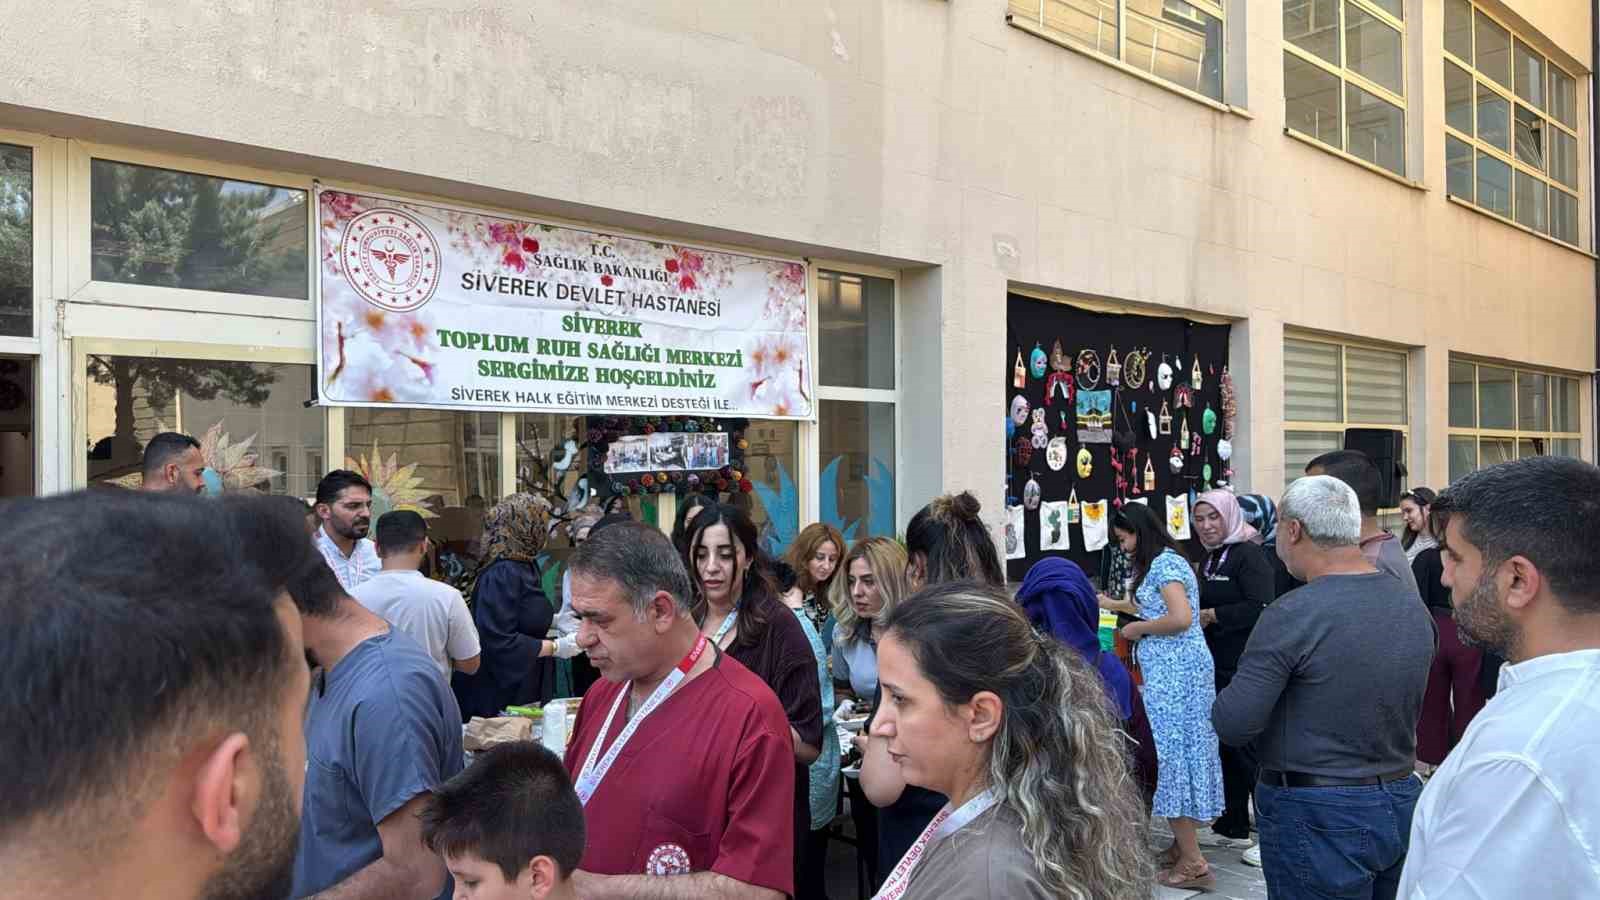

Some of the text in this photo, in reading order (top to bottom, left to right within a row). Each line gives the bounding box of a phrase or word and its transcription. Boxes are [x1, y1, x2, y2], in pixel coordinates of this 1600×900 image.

[591, 243, 616, 259] T.C.
[534, 254, 670, 282] SAĞLIK BAKANLIĞI
[461, 270, 721, 317] SİVEREK DEVLET HASTANESİ
[562, 312, 643, 338] SİVEREK
[436, 329, 744, 368] TOPLUM RUH SAĞLIĞI MERKEZİ
[478, 358, 716, 390] SERGİMİZE HOŞGELDİNİZ
[451, 385, 739, 411] SİVEREK HALK EĞİTİM MERKEZİ DESTEĞİ İLE...
[895, 844, 923, 879] DEVLET
